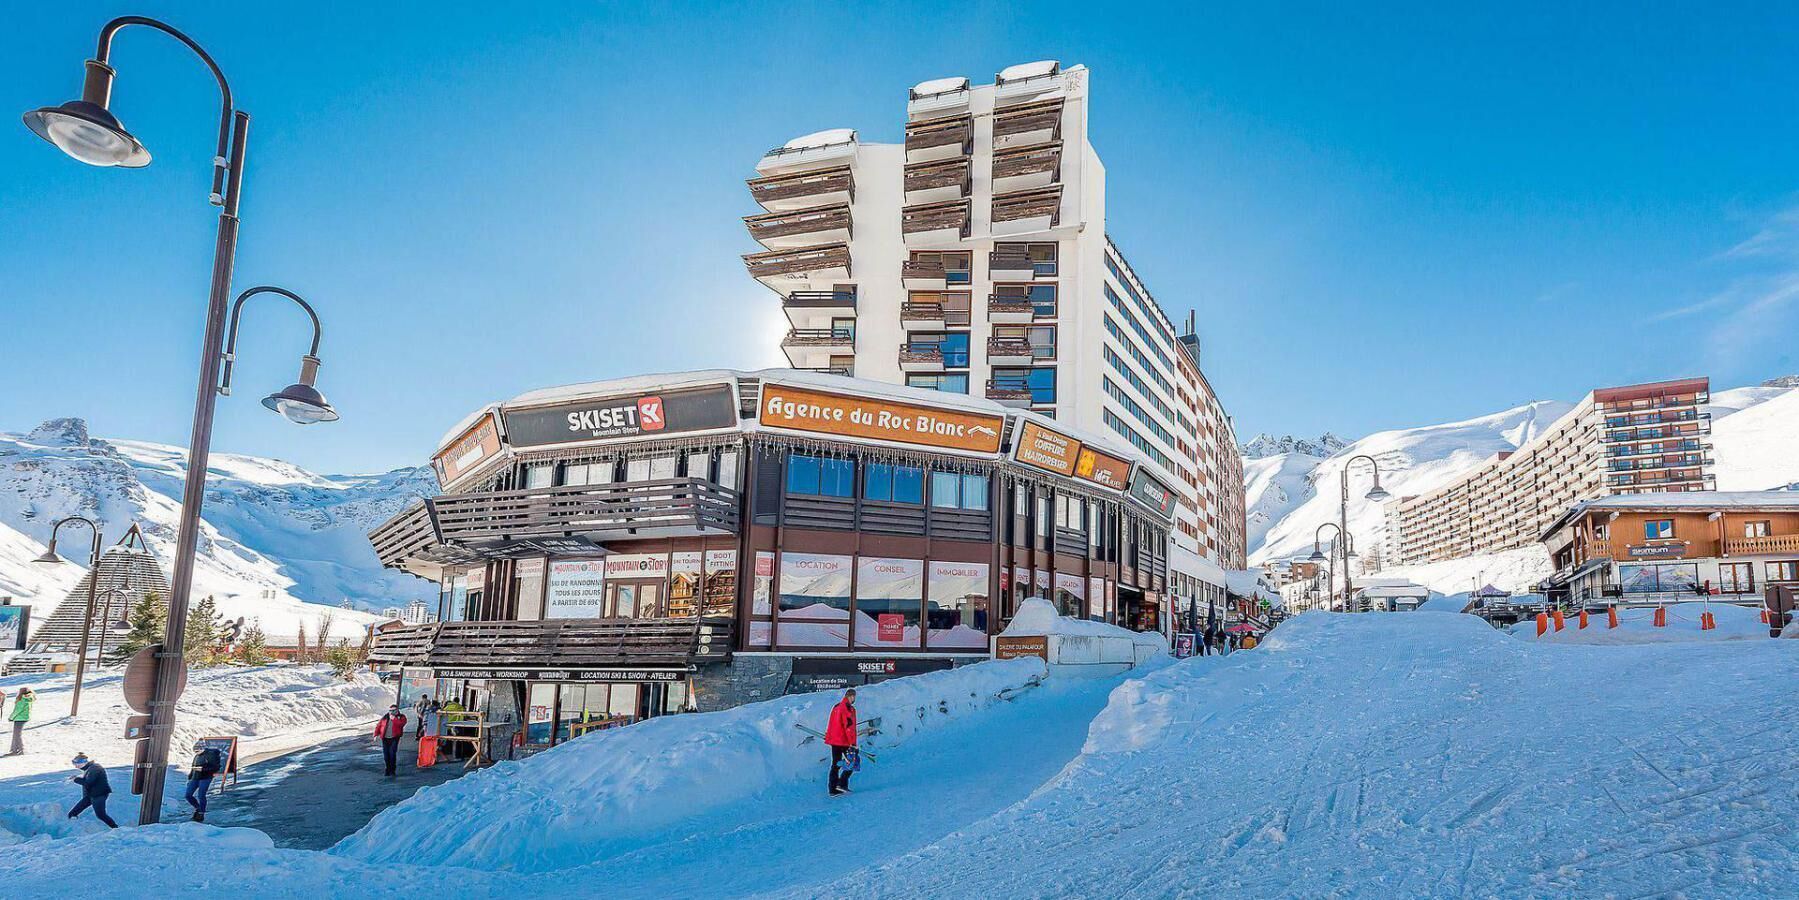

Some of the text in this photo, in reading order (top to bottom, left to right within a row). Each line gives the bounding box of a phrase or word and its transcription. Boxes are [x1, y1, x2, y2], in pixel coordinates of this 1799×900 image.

[567, 406, 638, 431] SKISET
[767, 396, 965, 437] Agence du Roc Blanc
[592, 427, 640, 437] Mountain Story
[606, 560, 640, 574] MOUNTAIN
[795, 561, 839, 570] LOCATION
[874, 565, 906, 573] CONSEIL
[936, 568, 979, 577] IMMOBILIER
[857, 662, 886, 670] SKISET
